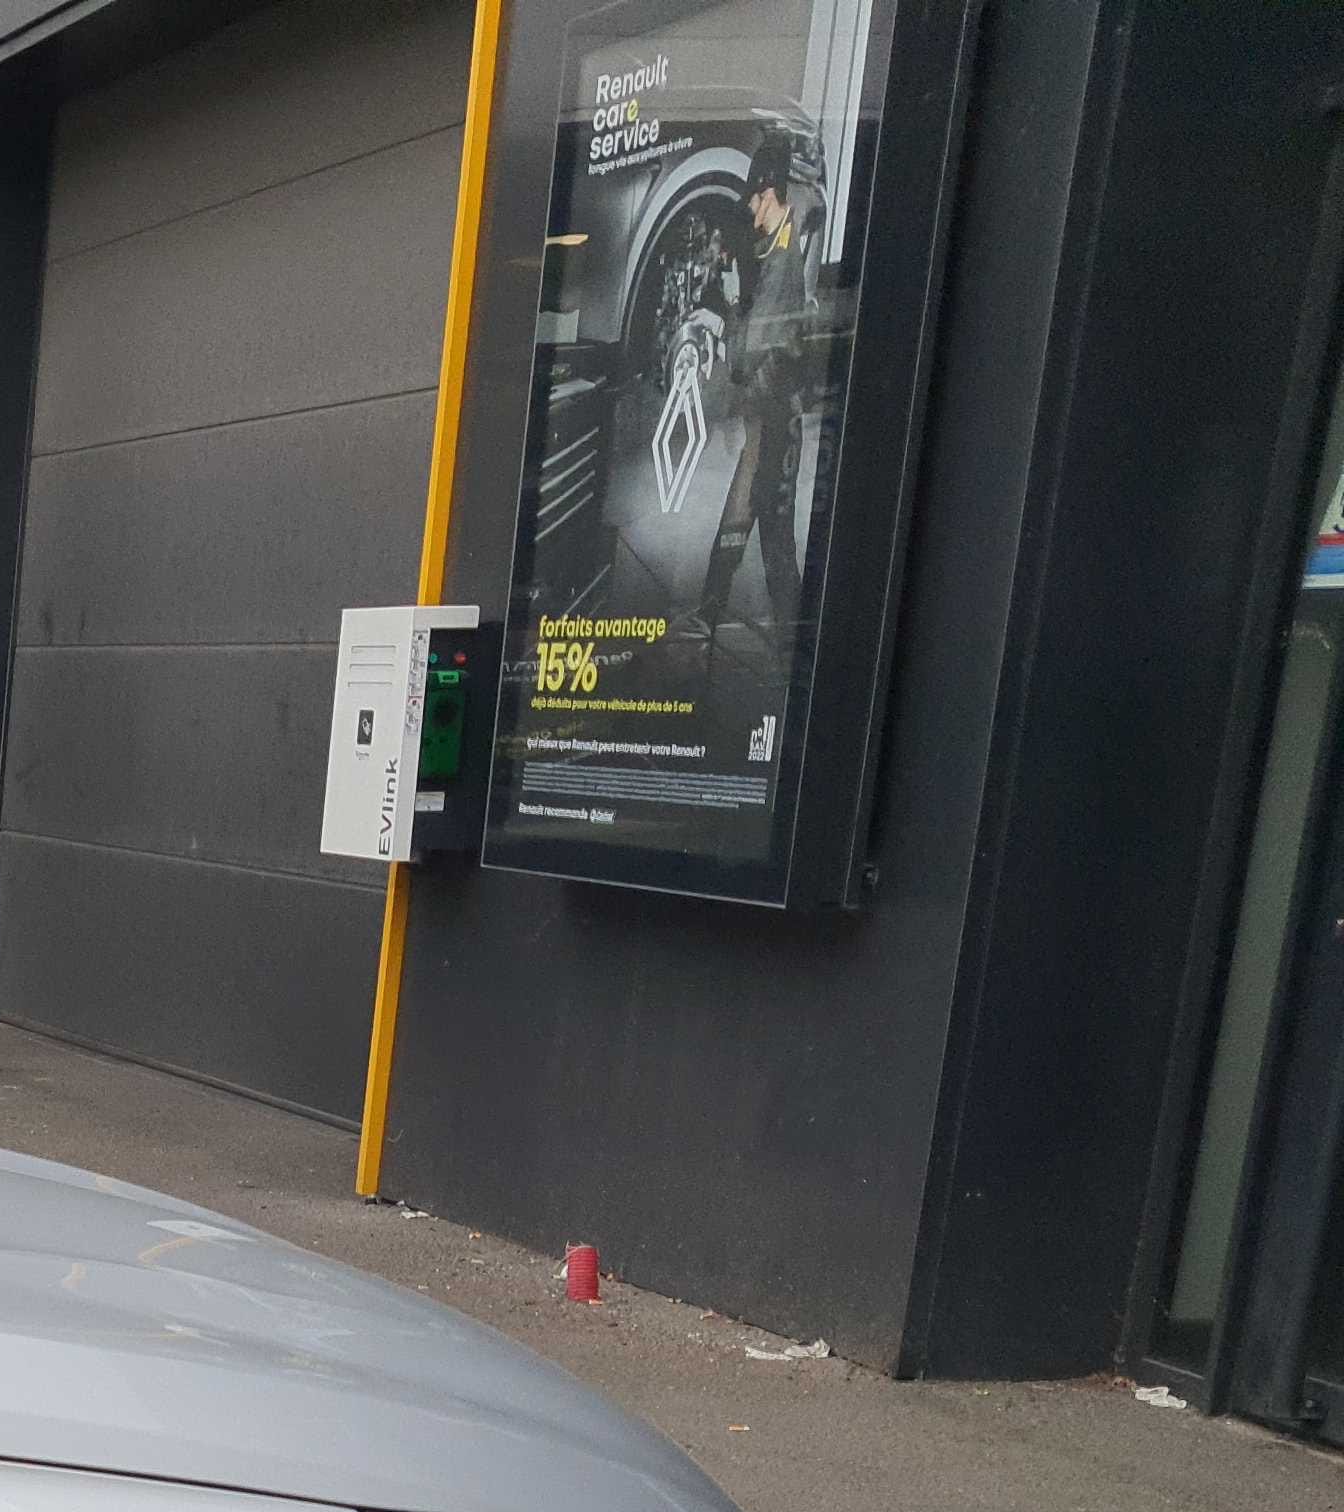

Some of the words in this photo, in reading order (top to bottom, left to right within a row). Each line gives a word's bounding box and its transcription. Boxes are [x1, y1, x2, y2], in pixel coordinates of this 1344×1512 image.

[595, 54, 670, 104] Renault
[593, 98, 639, 132] care
[589, 118, 660, 160] service
[538, 614, 593, 639] forfaits
[595, 616, 667, 643] avantage
[536, 641, 598, 692] 15%
[378, 757, 398, 856] EVlink
